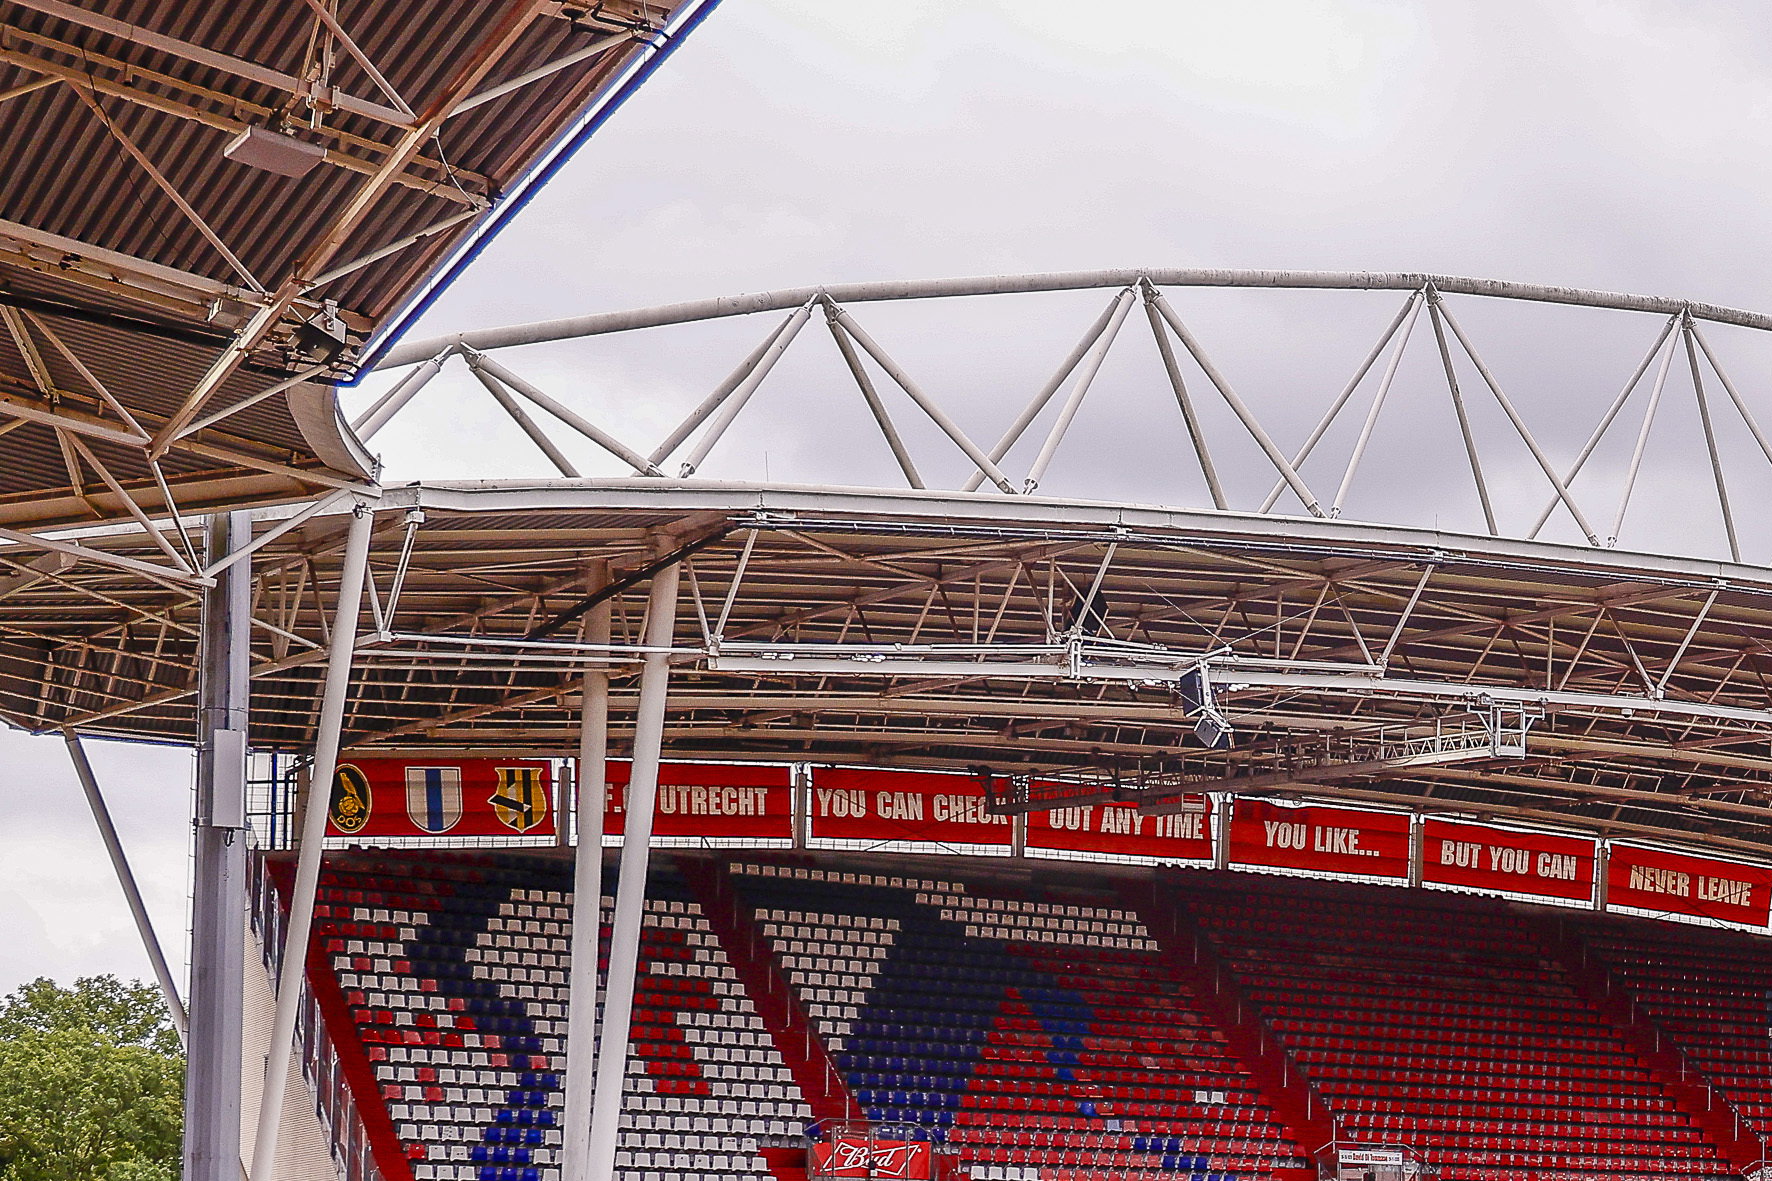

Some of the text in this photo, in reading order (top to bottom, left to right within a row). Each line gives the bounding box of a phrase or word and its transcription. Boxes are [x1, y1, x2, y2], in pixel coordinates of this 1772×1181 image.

[659, 784, 768, 816] UTRECHT
[816, 788, 867, 818] YOU
[877, 790, 924, 821] CAN
[1049, 806, 1204, 840] OUT ANY TIME
[1264, 820, 1381, 857] YOU LIKE...
[1440, 839, 1578, 881] BUT YOU CAN
[1629, 864, 1753, 908] NEVER LEAVE
[840, 1145, 895, 1170] Bud
